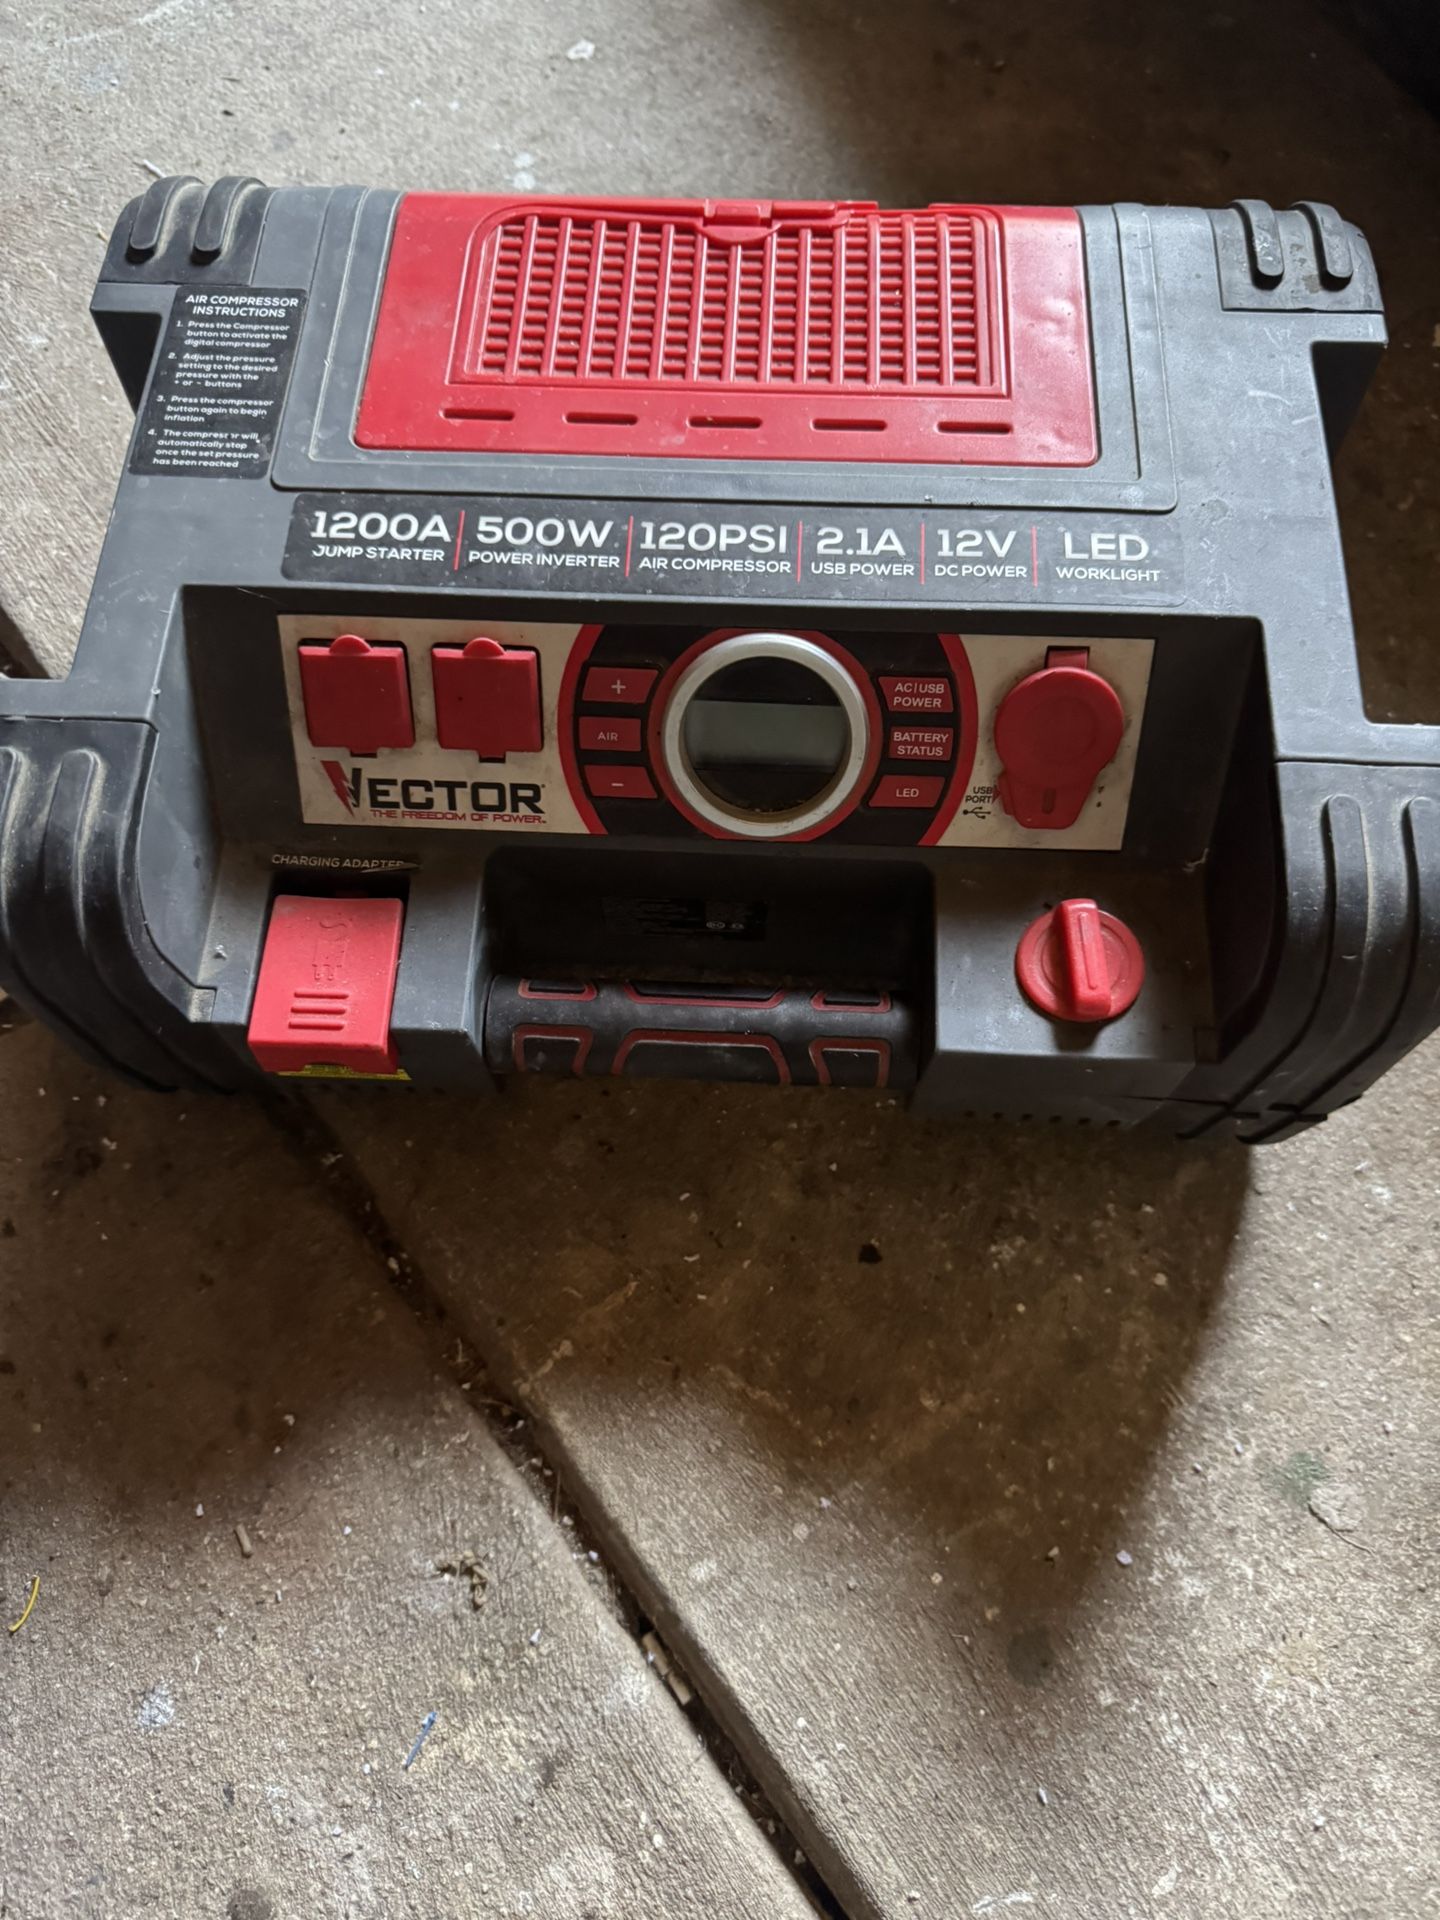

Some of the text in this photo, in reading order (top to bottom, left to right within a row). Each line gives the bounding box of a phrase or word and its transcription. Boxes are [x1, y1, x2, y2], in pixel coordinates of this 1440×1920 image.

[185, 295, 299, 307] AIR COMPRESSOR
[192, 306, 286, 318] INSTRUCTIONS
[187, 321, 215, 329] Press
[216, 321, 232, 330] the
[233, 322, 290, 331] Compressor
[186, 330, 218, 338] button
[231, 332, 270, 340] activate
[184, 338, 214, 348] digital
[183, 353, 214, 362] Adjust
[178, 363, 212, 371] setting
[171, 395, 199, 403] Press
[200, 396, 216, 404] the
[166, 405, 199, 413] button
[200, 407, 227, 415] again
[240, 407, 267, 417] begin
[163, 429, 182, 437] The
[157, 440, 224, 449] automatically
[180, 449, 197, 457] the
[214, 452, 259, 460] pressure
[172, 458, 197, 466] been
[198, 460, 239, 468] reached
[310, 511, 452, 543] 1200A
[476, 516, 614, 548] 500W
[639, 520, 788, 554] 120PSI
[816, 527, 907, 557] 2.1A
[937, 530, 1018, 558] 12V
[1062, 532, 1151, 561] LED
[312, 545, 445, 562] JUMP STARTER
[468, 552, 620, 569] POWER INVERTER
[638, 558, 792, 575] AIR COMPRESSOR
[810, 562, 915, 577] USB POWER
[934, 564, 1028, 579] DC POWER
[1056, 568, 1161, 583] WORKLIGHT
[893, 696, 942, 708] POWER
[597, 731, 619, 741] AIR
[893, 731, 949, 743] BATTERY
[897, 745, 943, 756] STATUS
[320, 760, 545, 817] VECTOR
[895, 788, 919, 798] LED
[972, 786, 993, 794] USB
[965, 795, 993, 804] PORT
[370, 809, 398, 819] THE
[401, 810, 467, 822] FREEDOM
[471, 814, 489, 822] OF
[271, 854, 340, 868] CHARGING
